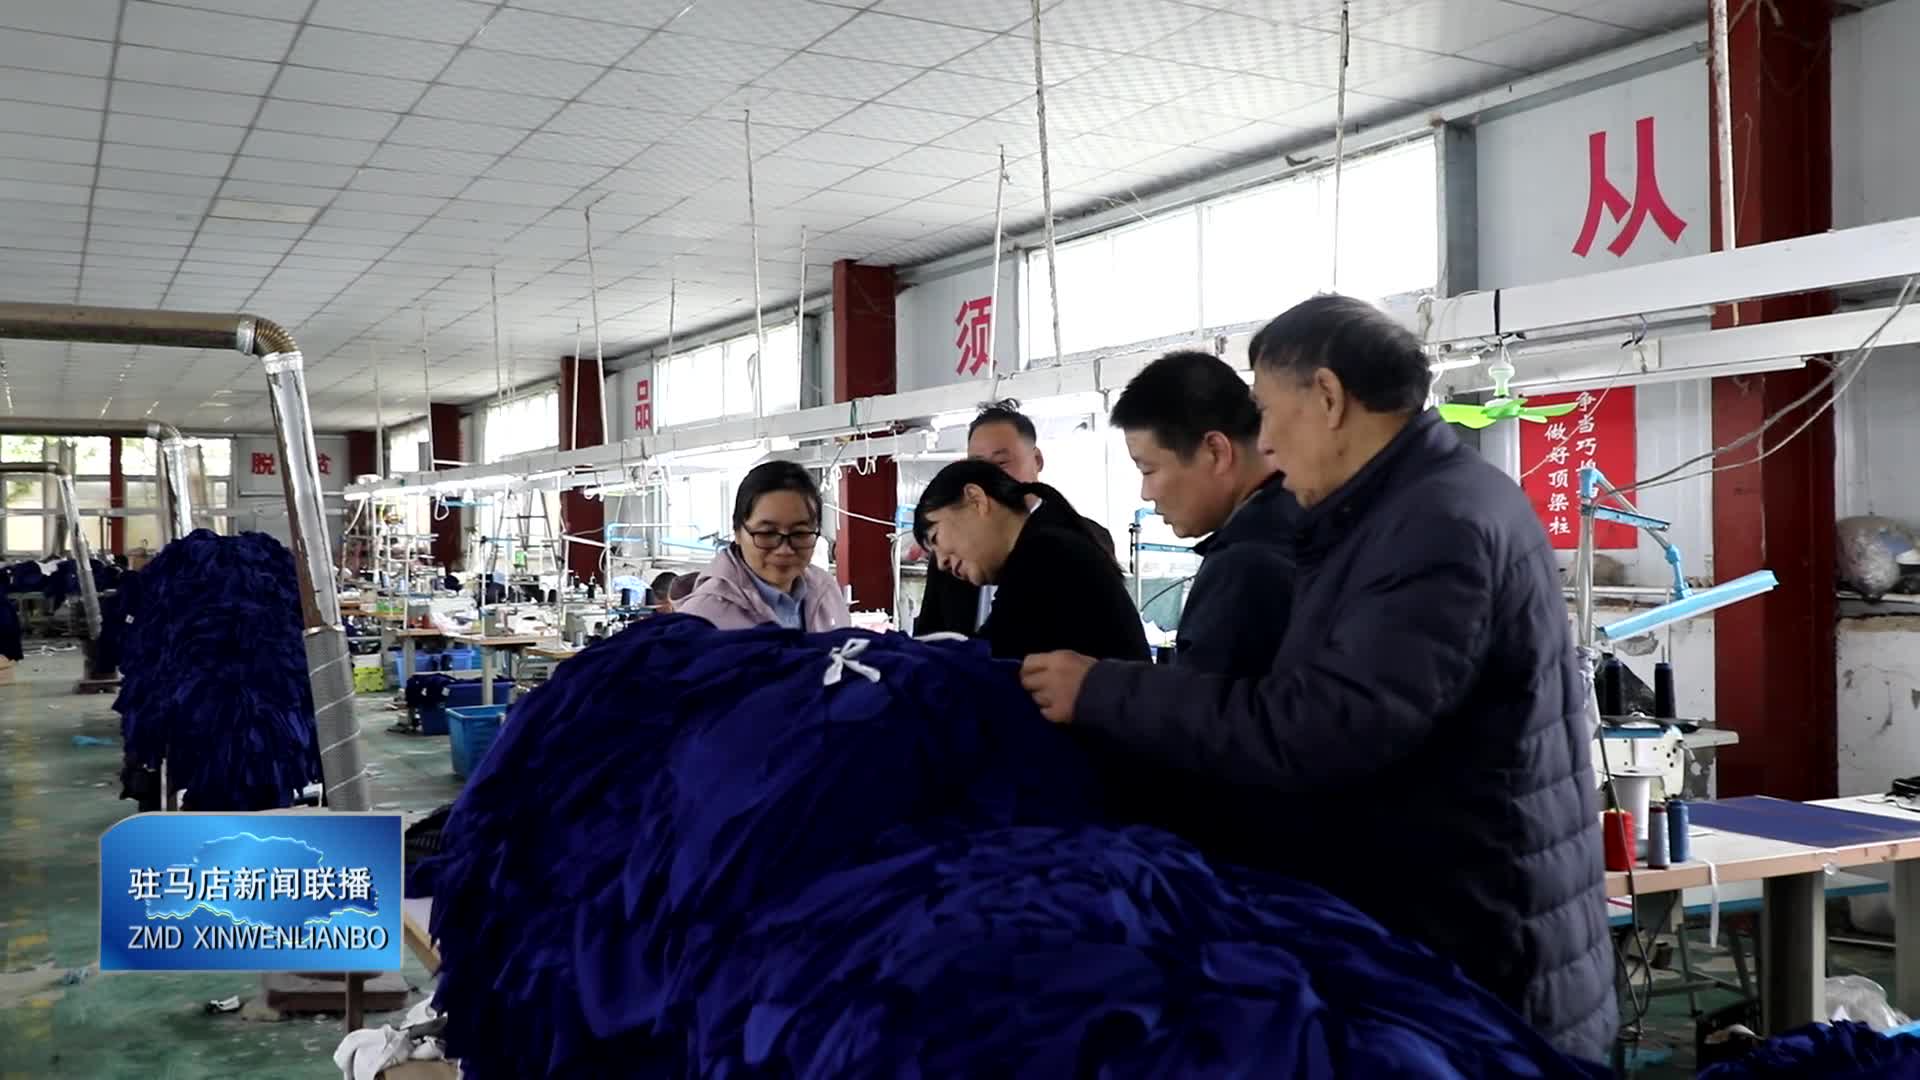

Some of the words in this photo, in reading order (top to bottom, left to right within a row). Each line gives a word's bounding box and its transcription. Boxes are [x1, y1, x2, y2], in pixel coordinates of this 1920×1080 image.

[1572, 117, 1687, 258] 从
[955, 296, 998, 376] 须
[635, 380, 650, 430] 品
[1545, 423, 1570, 535] 做好顶梁柱
